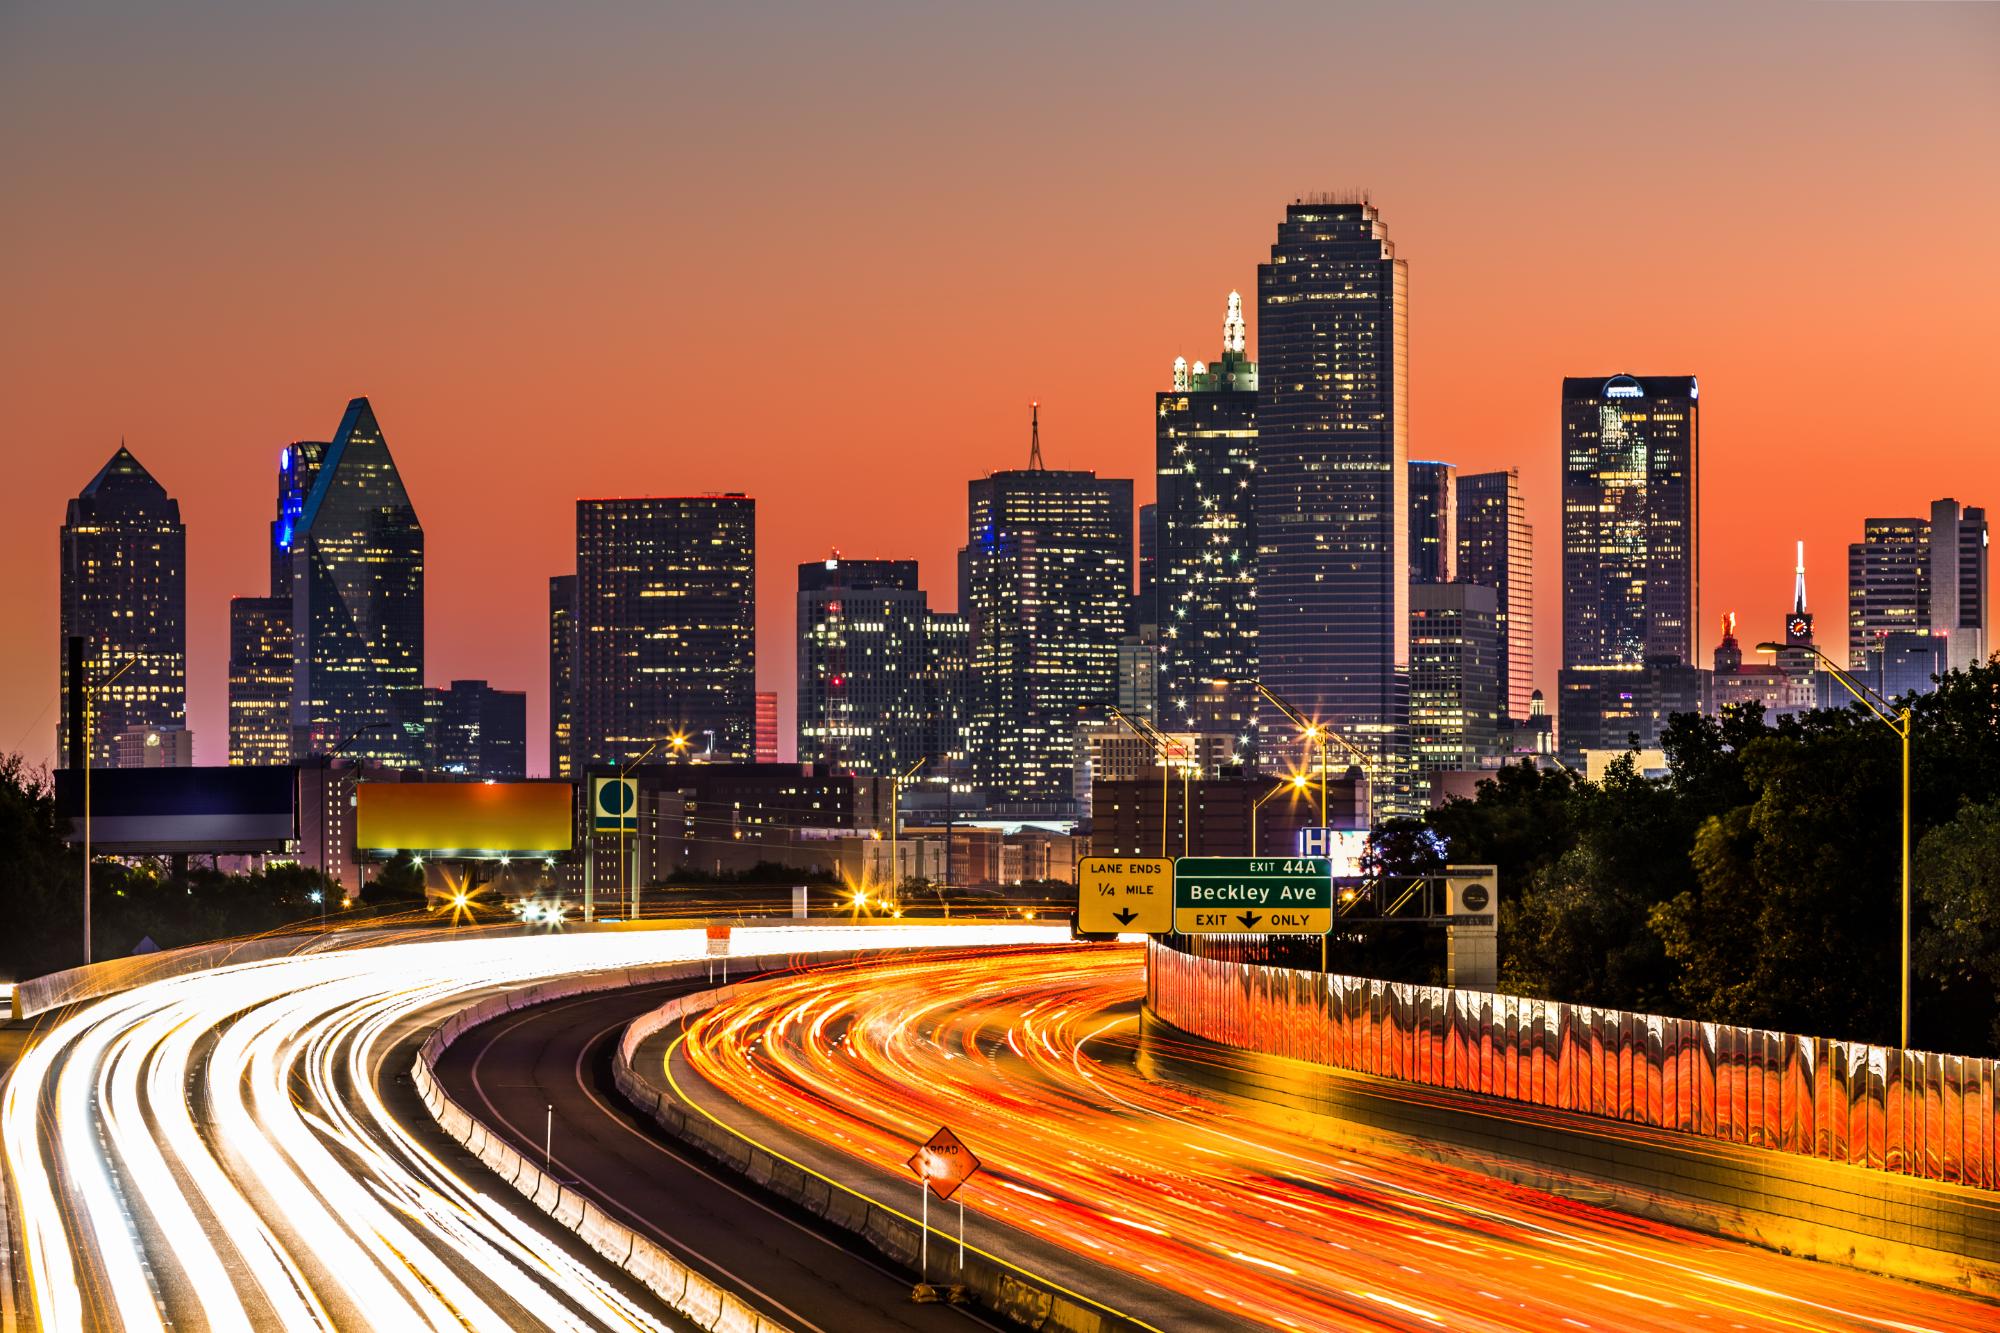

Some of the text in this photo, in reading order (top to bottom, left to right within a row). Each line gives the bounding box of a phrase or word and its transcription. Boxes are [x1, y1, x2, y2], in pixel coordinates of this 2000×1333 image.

[1306, 829, 1326, 855] H
[1091, 864, 1161, 874] LANE ENDS
[1250, 860, 1316, 874] EXIT 44A
[1126, 885, 1154, 895] MILE
[1191, 885, 1317, 904] Beckley Ave
[1196, 914, 1310, 925] EXIT ONLY
